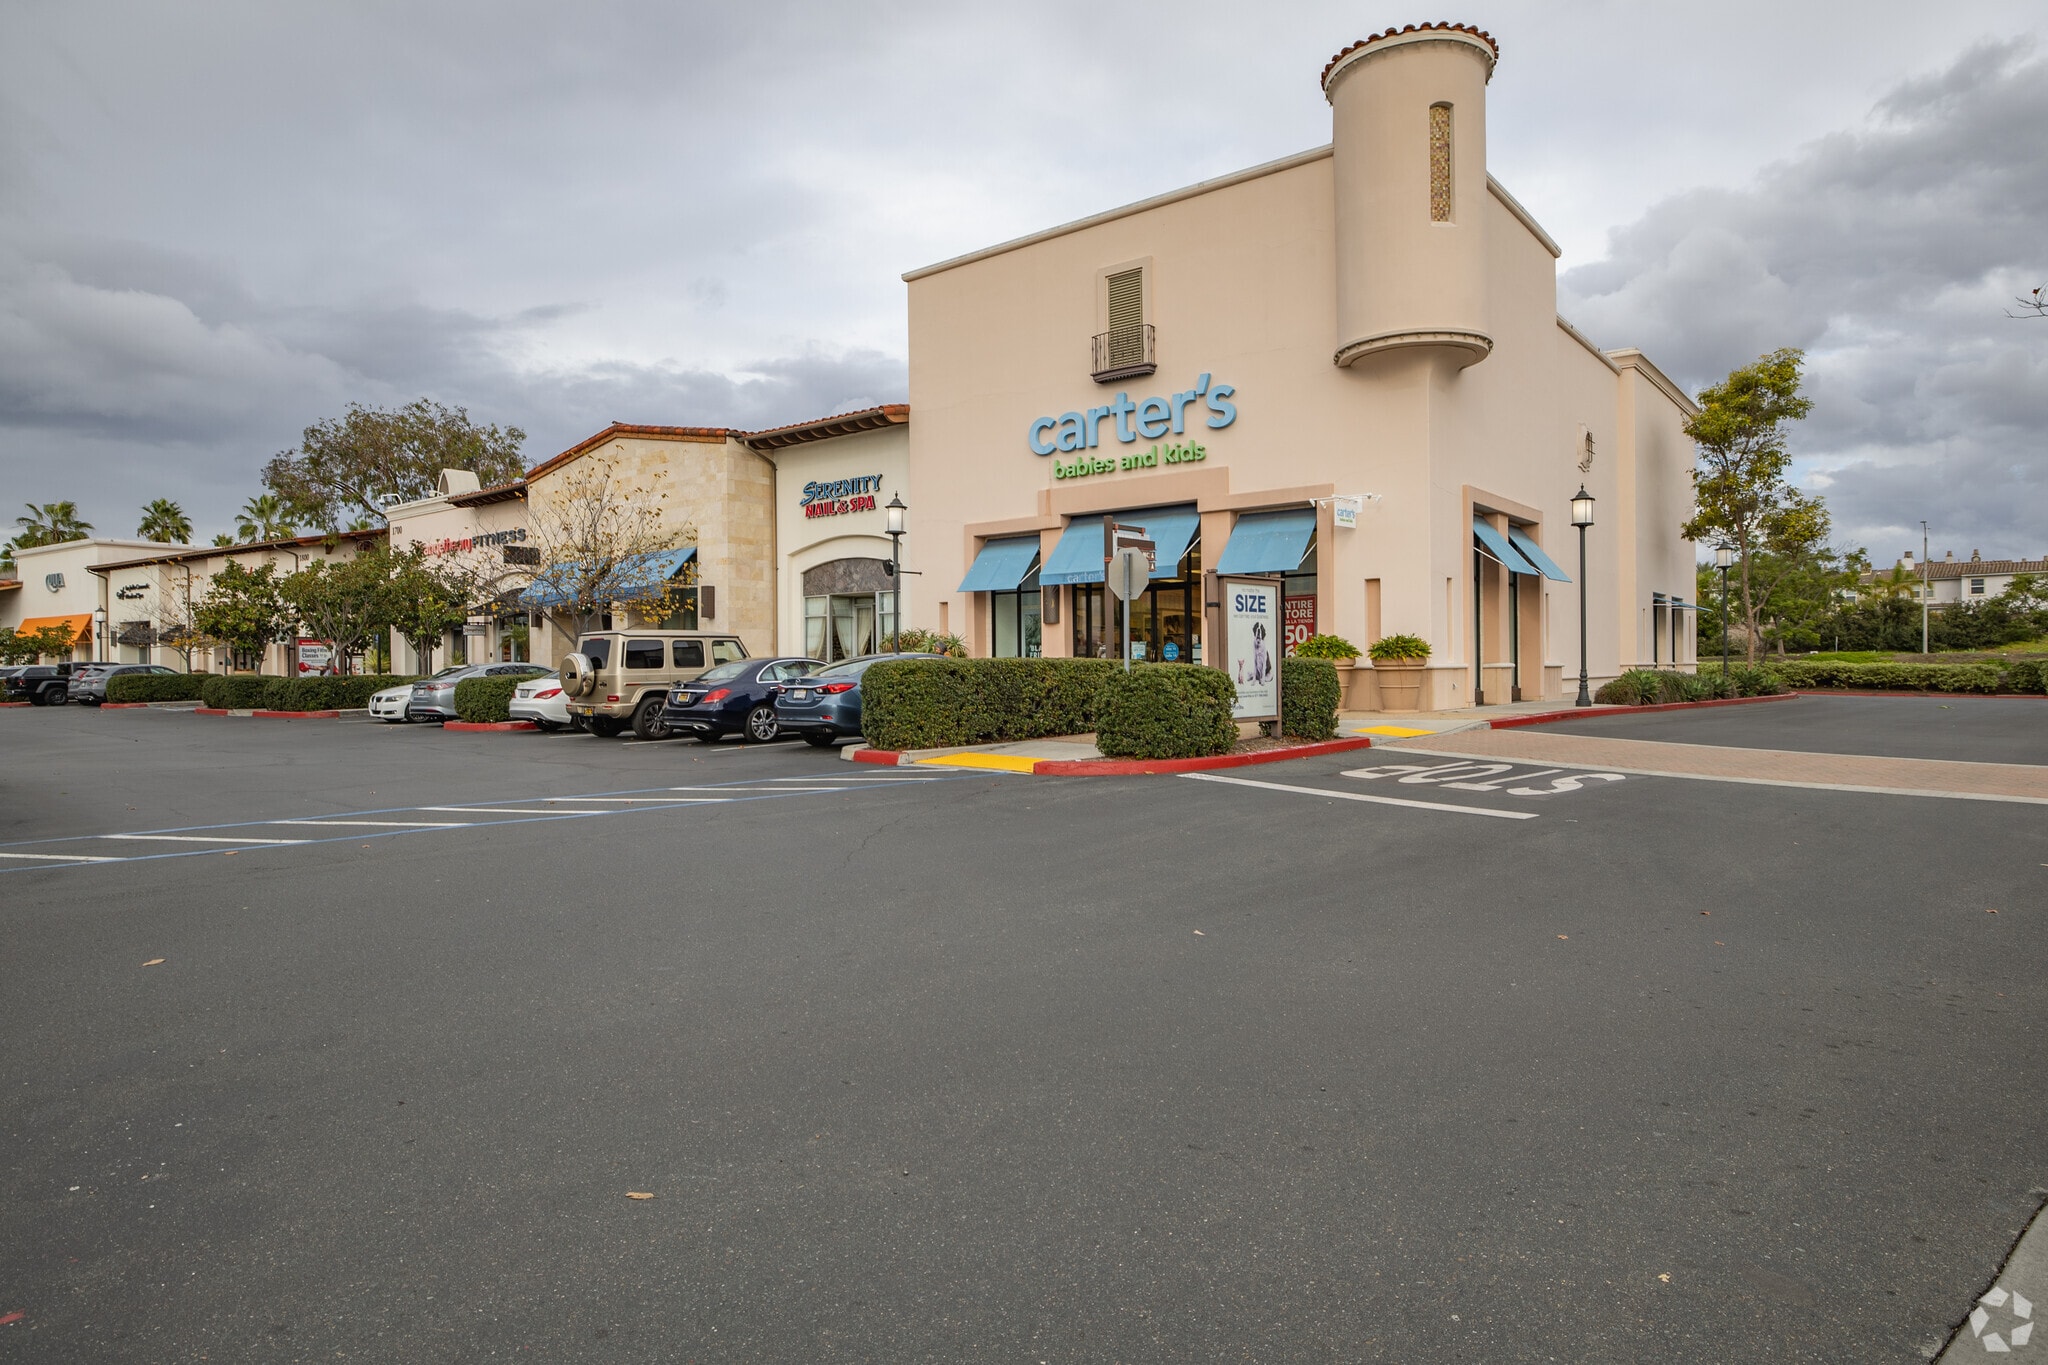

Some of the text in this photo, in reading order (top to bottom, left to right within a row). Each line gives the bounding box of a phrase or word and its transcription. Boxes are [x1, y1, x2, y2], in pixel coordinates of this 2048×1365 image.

[1028, 373, 1237, 456] carter's
[1053, 440, 1206, 479] babies and kids
[805, 495, 876, 518] NAIL & SPA
[392, 526, 403, 535] 1700
[472, 528, 526, 548] FITNESS
[299, 553, 309, 561] 1800
[1235, 593, 1266, 612] SIZE
[1285, 600, 1313, 610] NTIRE
[1285, 609, 1313, 619] TORE
[1340, 761, 1626, 796] STOP
